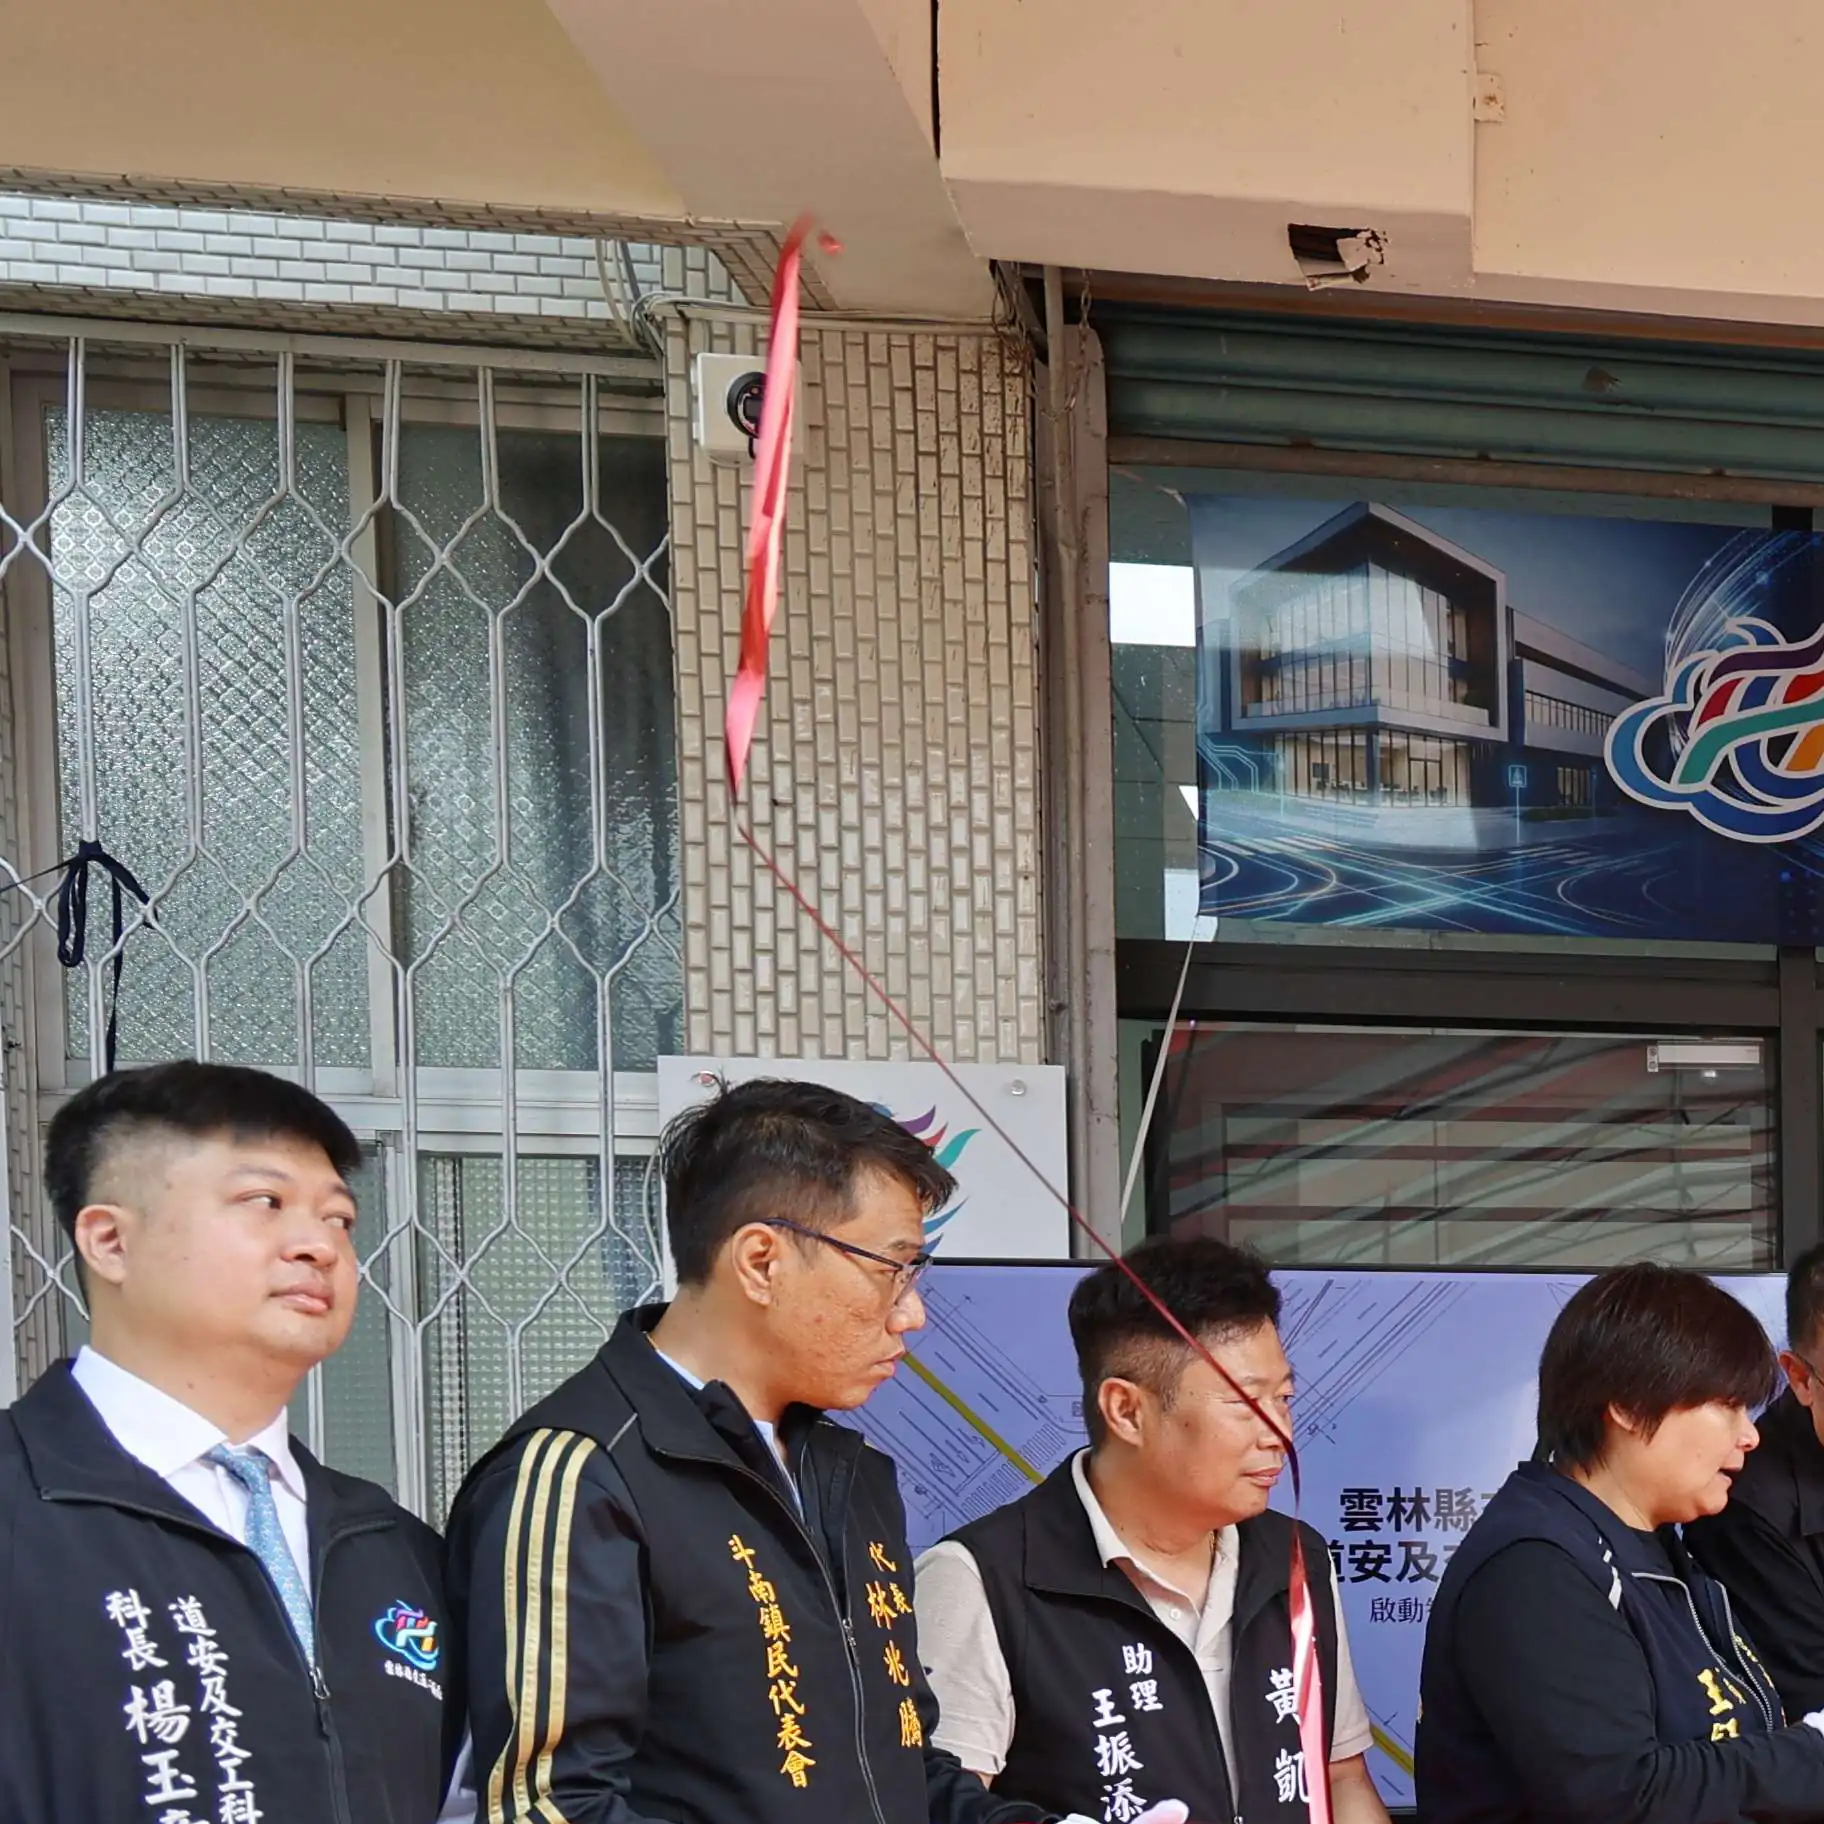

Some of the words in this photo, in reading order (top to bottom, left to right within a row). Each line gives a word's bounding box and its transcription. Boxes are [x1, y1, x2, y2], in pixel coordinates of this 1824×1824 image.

[1339, 1486, 1496, 1533] 雲林縣
[105, 1588, 168, 1671] 科長
[728, 1534, 816, 1788] 斗南鎮民代表會
[1121, 1642, 1164, 1712] 助理
[1091, 1688, 1147, 1823] 王振添
